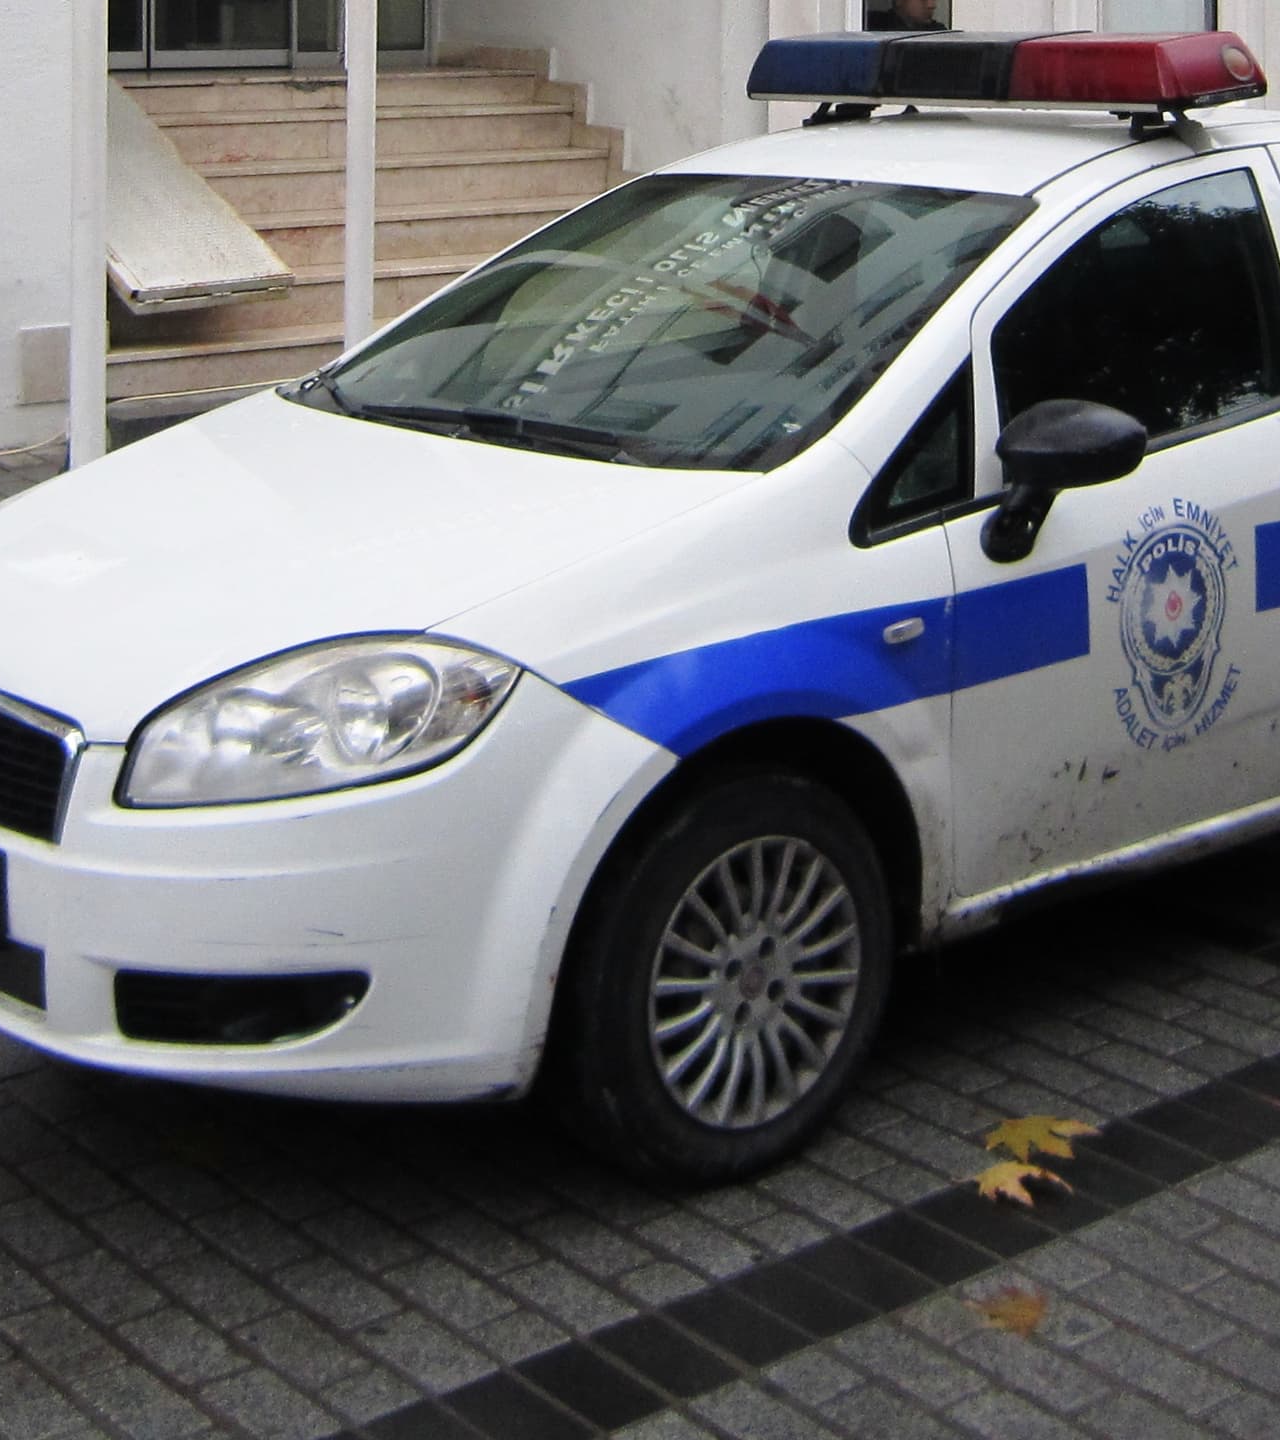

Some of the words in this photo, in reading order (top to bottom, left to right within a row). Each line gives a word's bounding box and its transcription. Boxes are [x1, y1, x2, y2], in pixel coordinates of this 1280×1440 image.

[1106, 530, 1138, 603] HALK
[1173, 498, 1240, 572] EMNİYET
[1137, 534, 1200, 575] POLİS
[1113, 687, 1159, 752] ADALET
